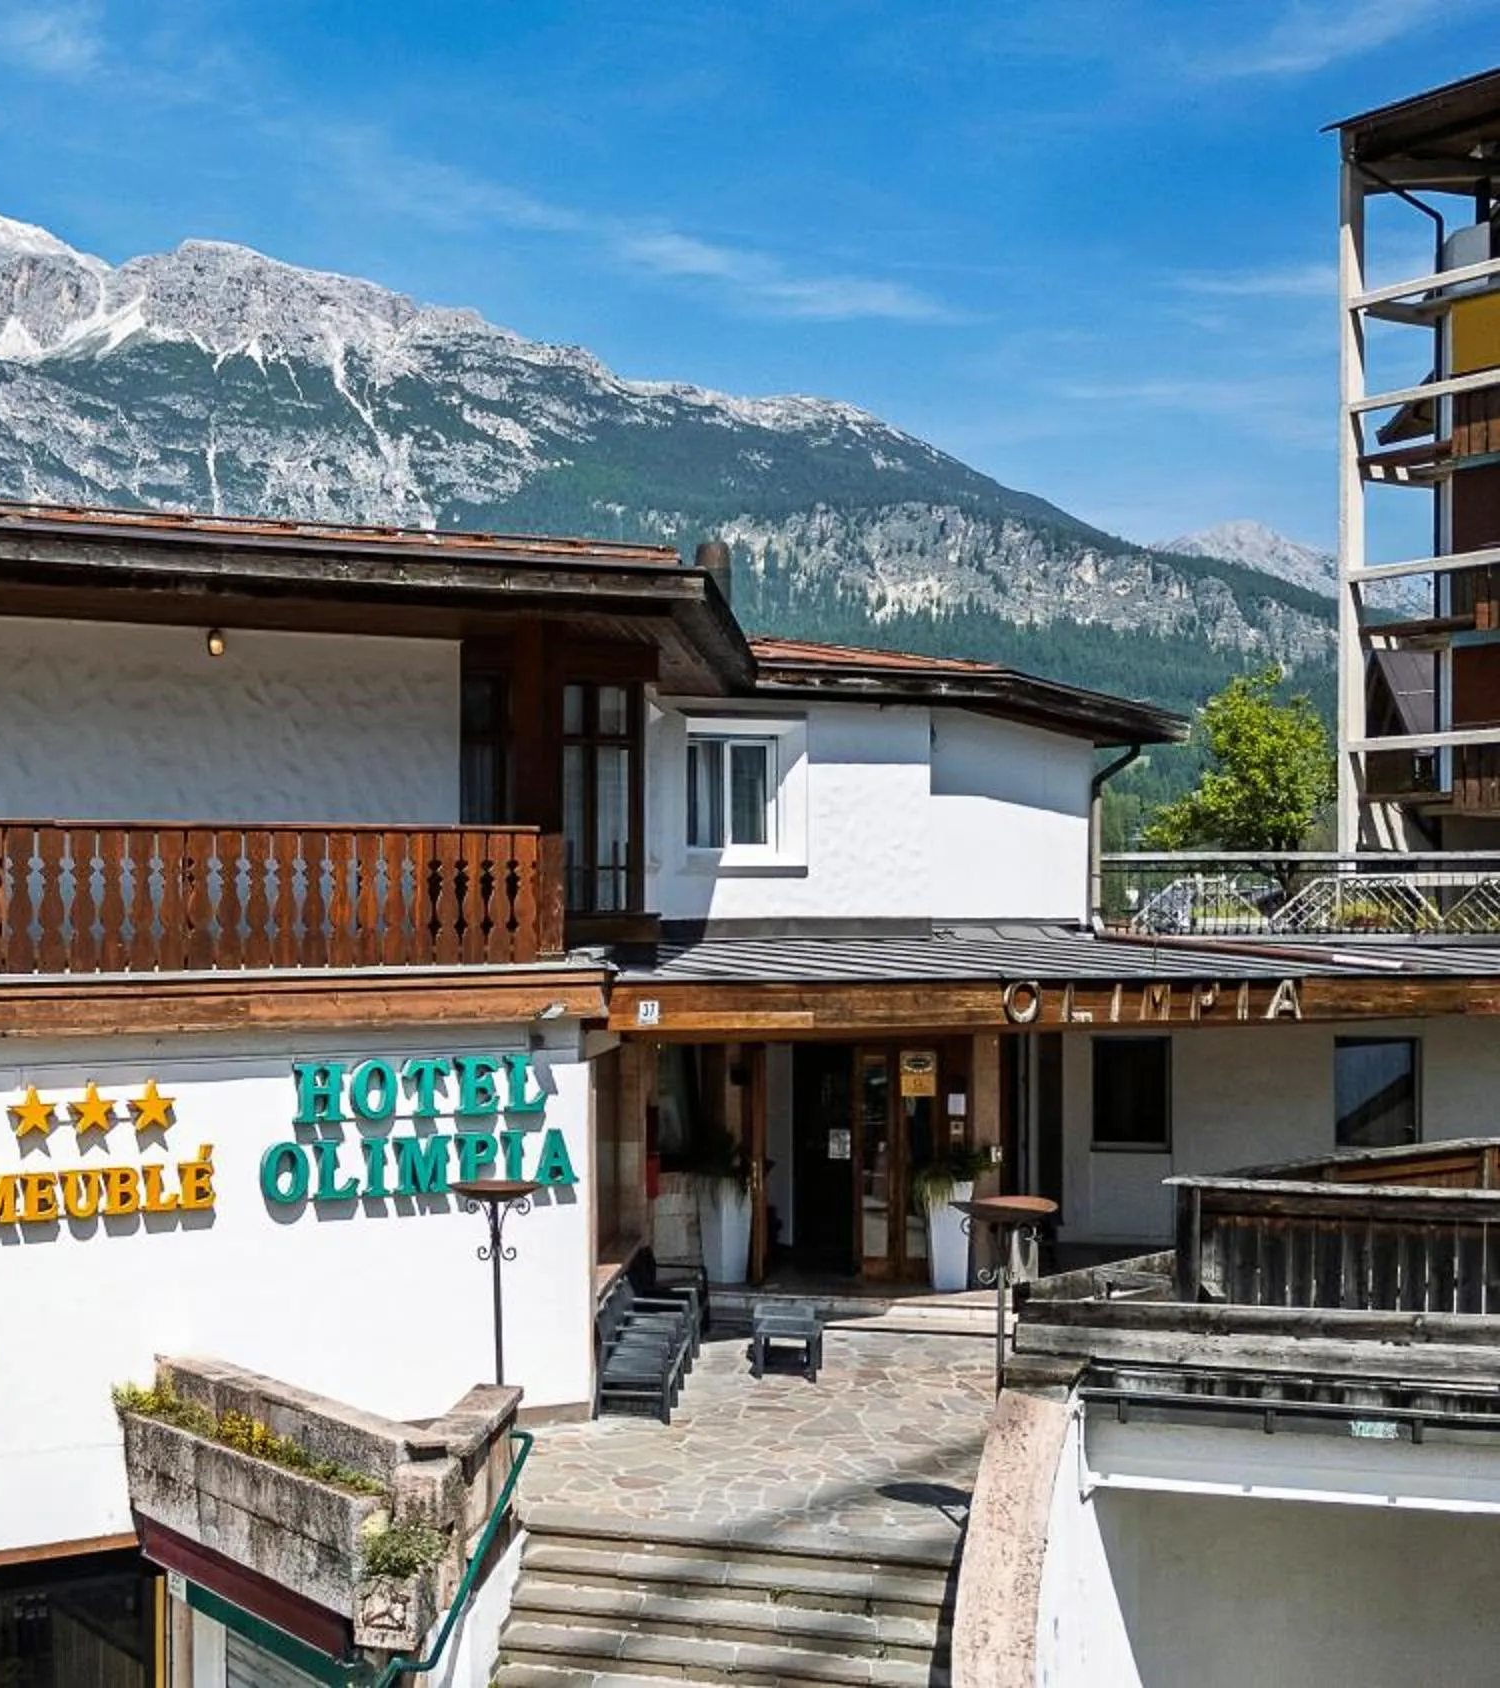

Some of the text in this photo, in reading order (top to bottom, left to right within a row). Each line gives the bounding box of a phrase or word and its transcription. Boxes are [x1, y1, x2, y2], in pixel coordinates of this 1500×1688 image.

[1002, 980, 1302, 1024] OLIMPIA
[291, 1052, 548, 1125] HOTEL
[258, 1127, 580, 1203] OLIMPIA
